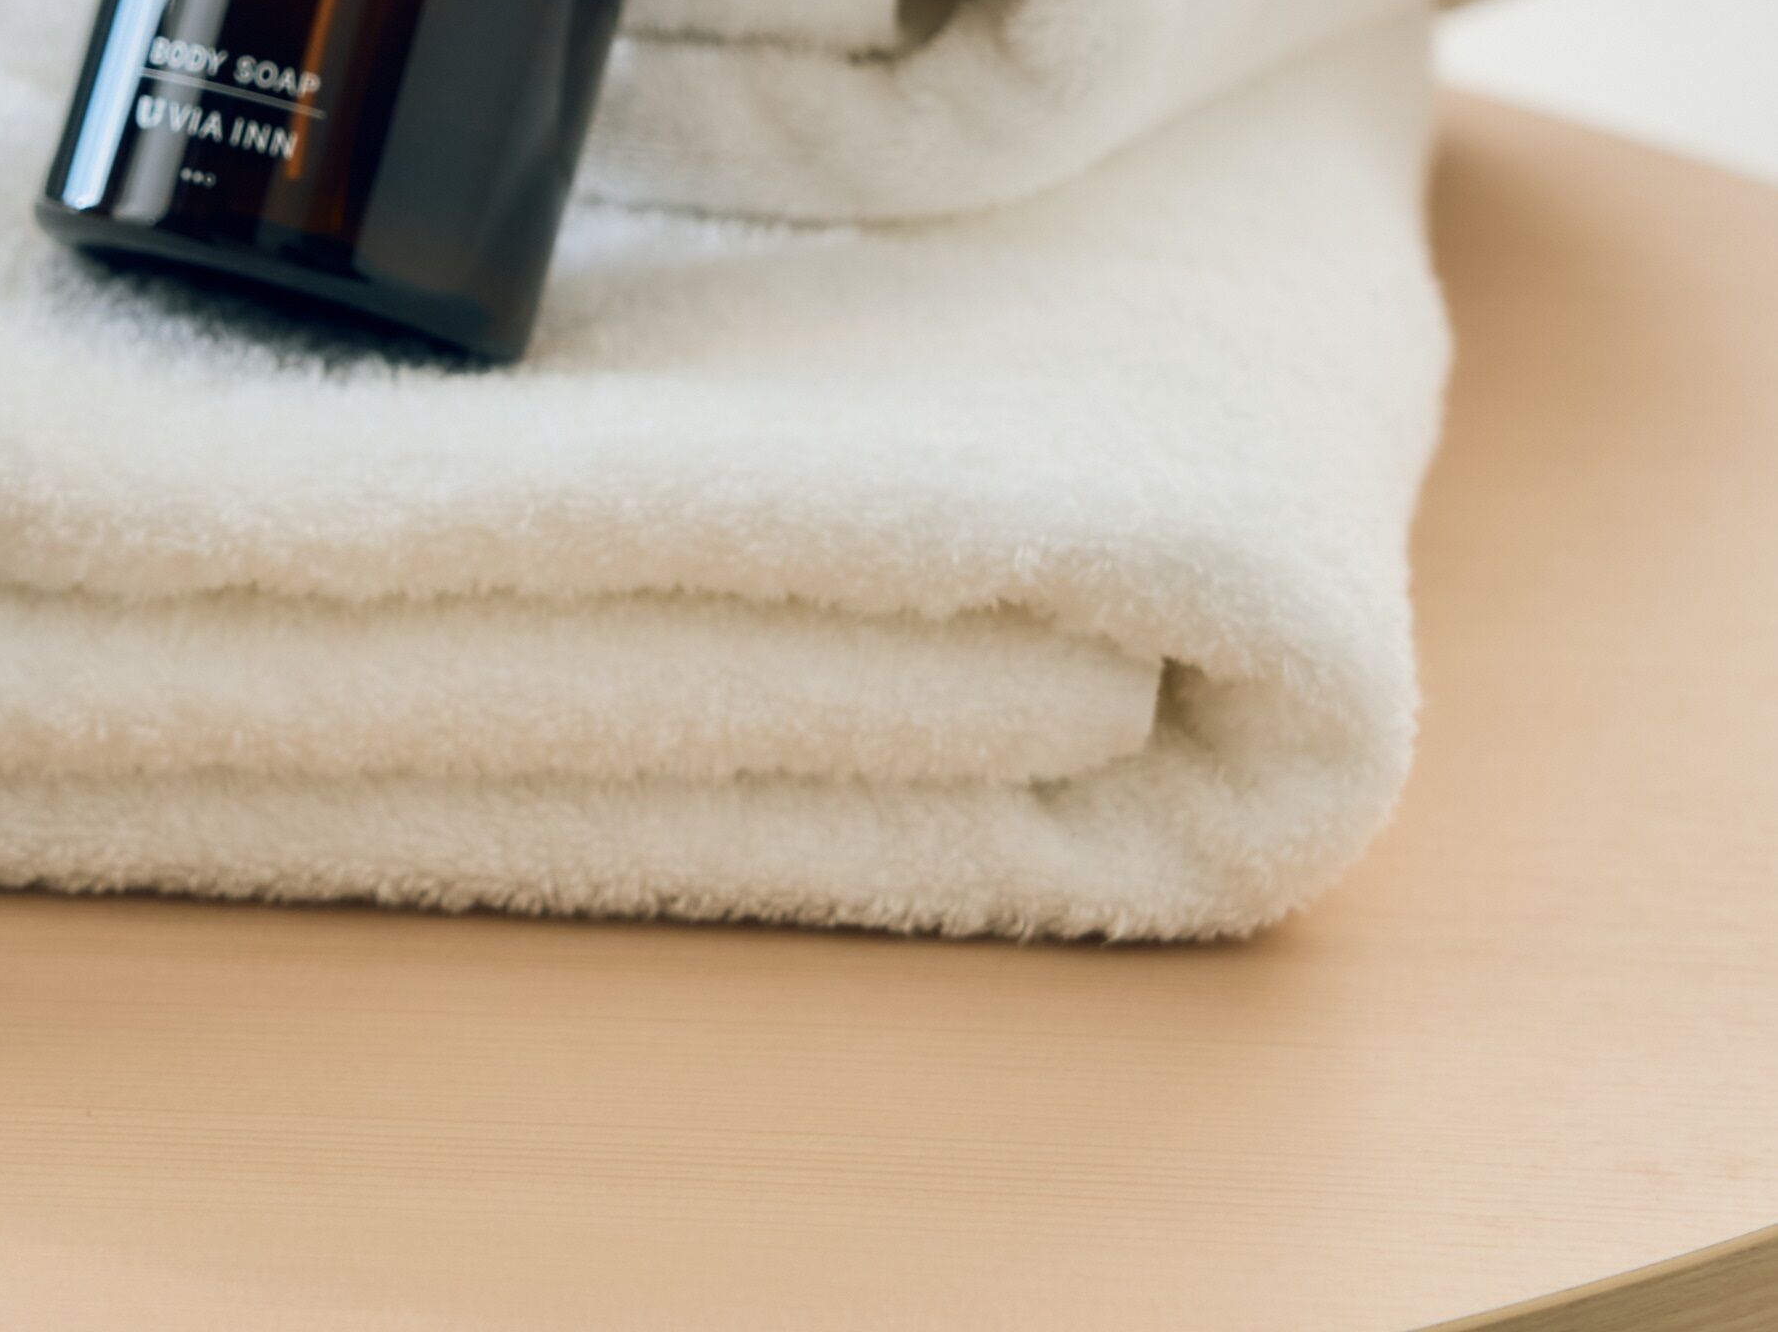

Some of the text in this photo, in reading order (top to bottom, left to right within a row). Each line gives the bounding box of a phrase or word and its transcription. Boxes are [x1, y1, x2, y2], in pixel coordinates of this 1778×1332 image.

[149, 36, 320, 98] BODY SOAP
[169, 101, 298, 160] VIA INN
